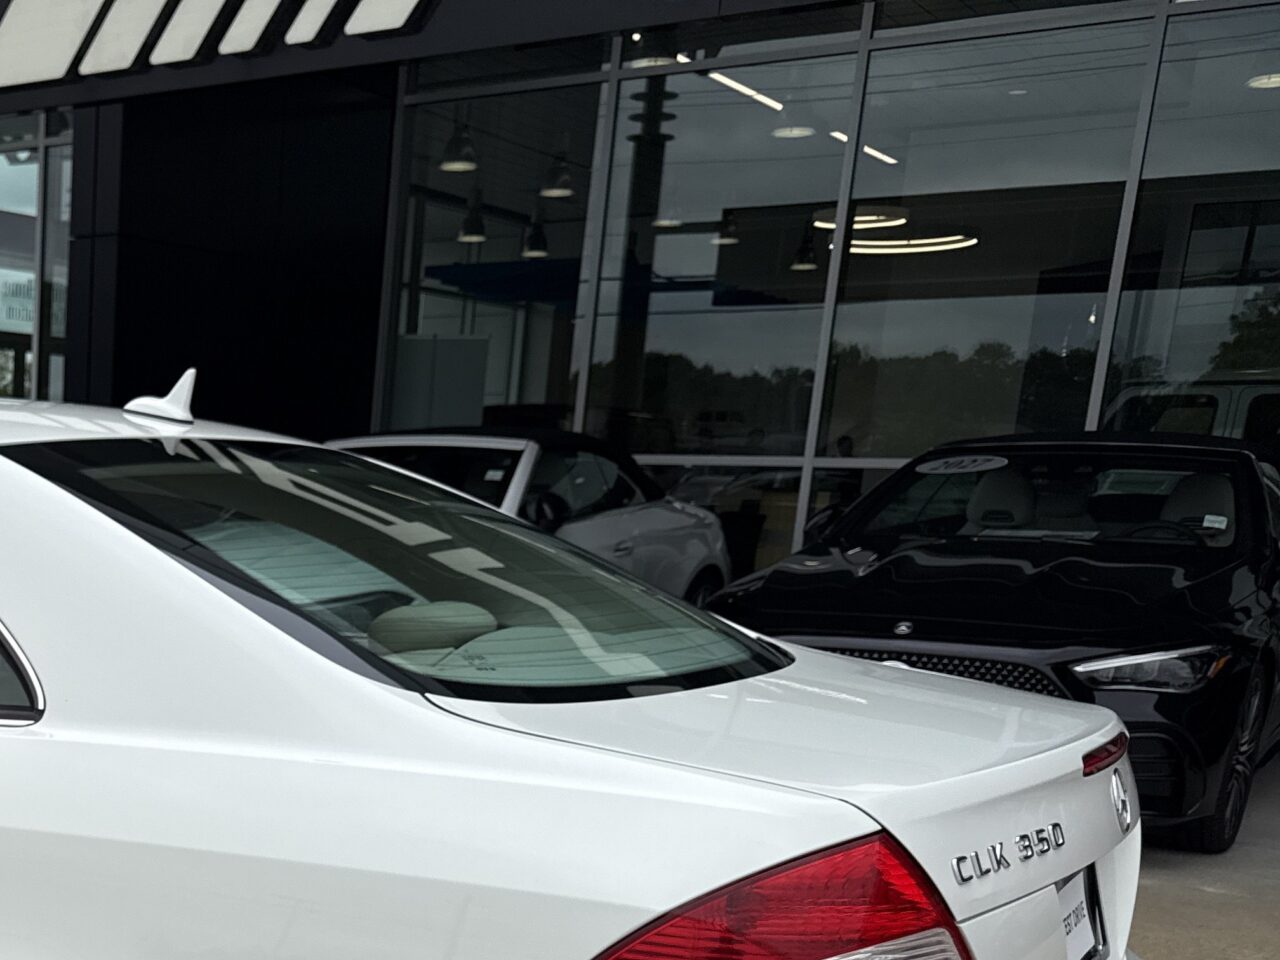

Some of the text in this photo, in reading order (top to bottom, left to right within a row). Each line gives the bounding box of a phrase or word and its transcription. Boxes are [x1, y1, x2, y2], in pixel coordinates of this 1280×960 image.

[951, 822, 1065, 885] CLK 350
[1063, 912, 1074, 936] EST
